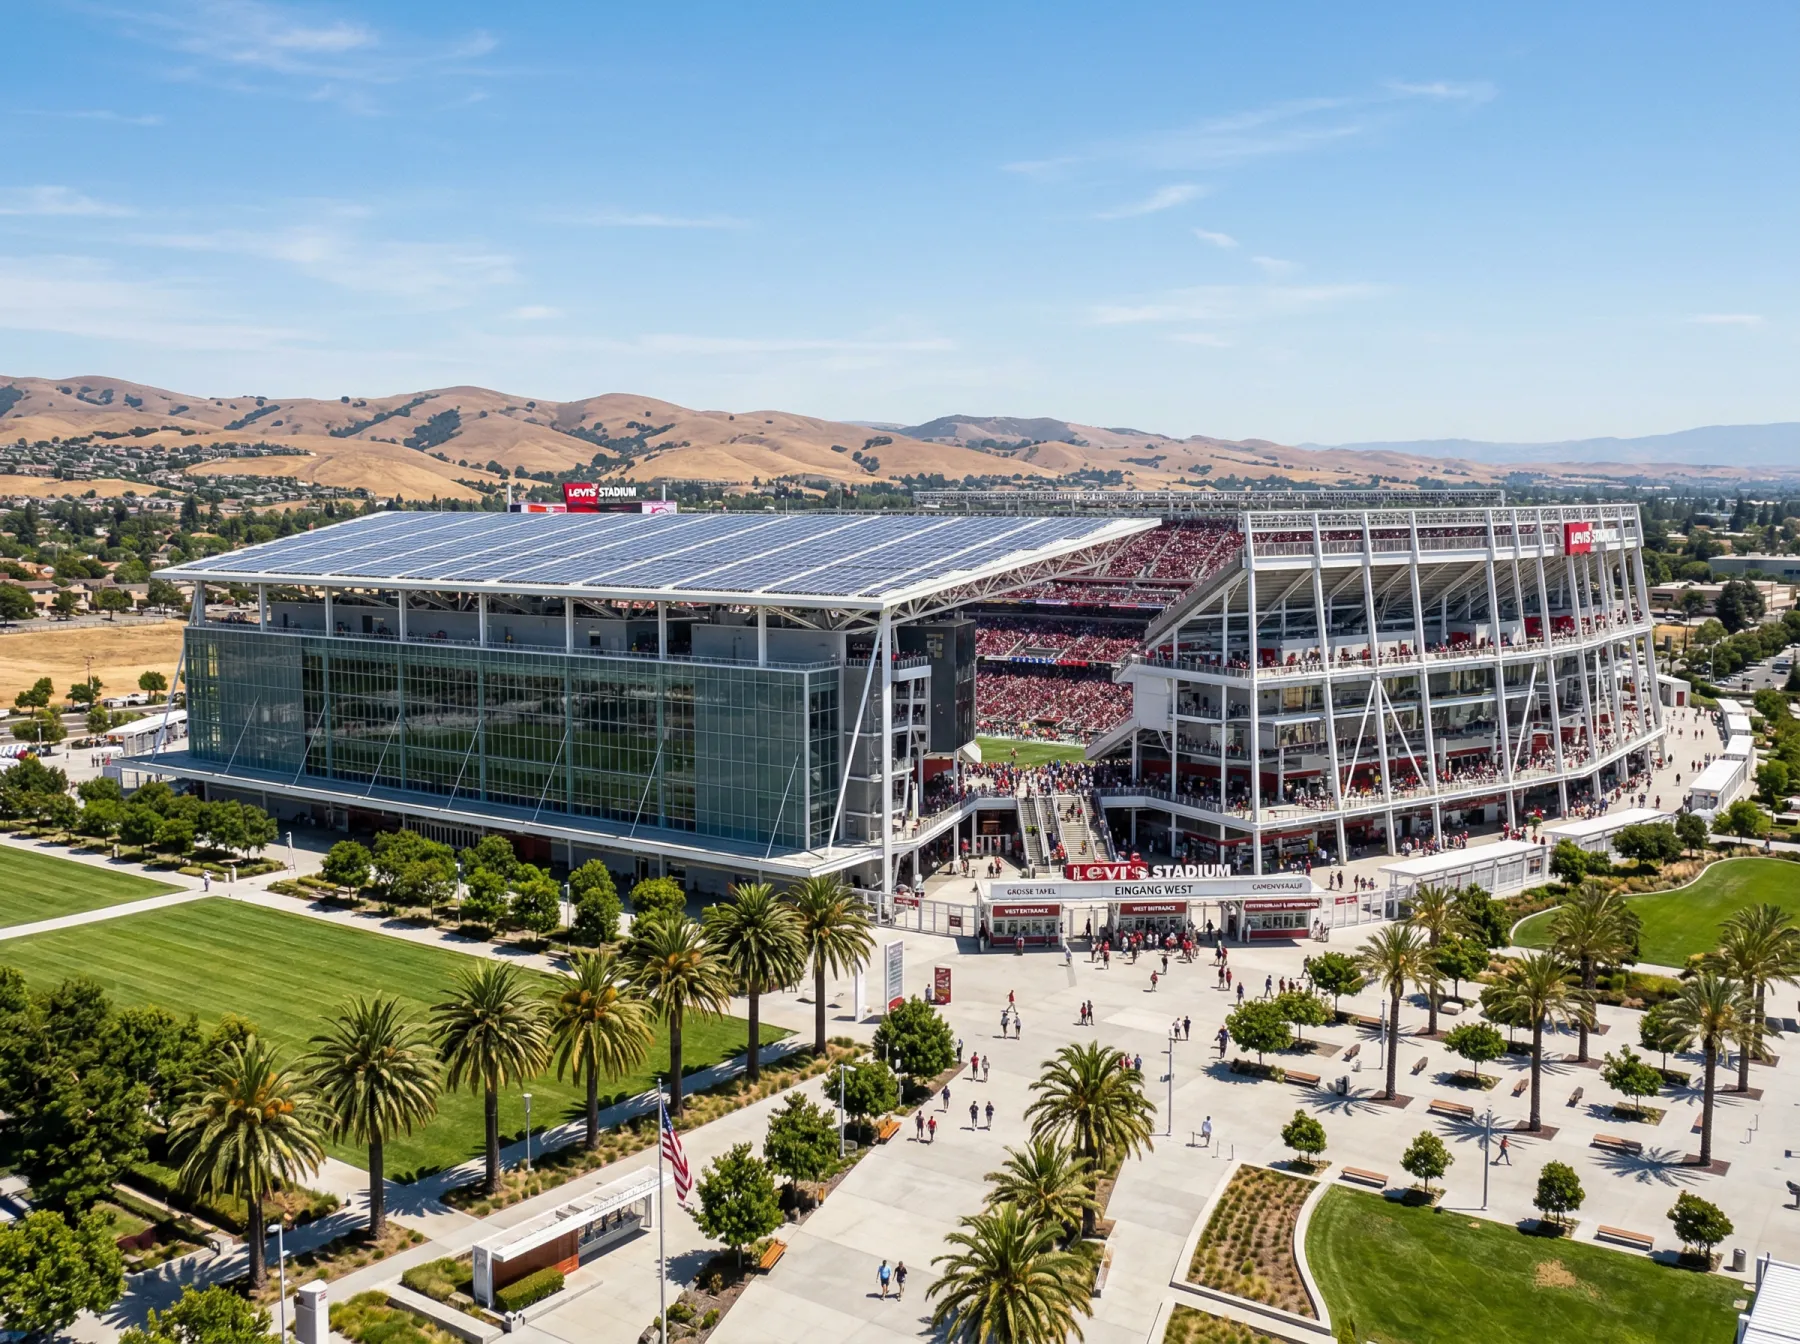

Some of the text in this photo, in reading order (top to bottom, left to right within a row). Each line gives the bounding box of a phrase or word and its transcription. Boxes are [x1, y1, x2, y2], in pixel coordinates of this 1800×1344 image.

[599, 486, 637, 497] STADIUM
[1152, 864, 1231, 879] STADIUM
[1115, 885, 1193, 896] EINGANG WEST
